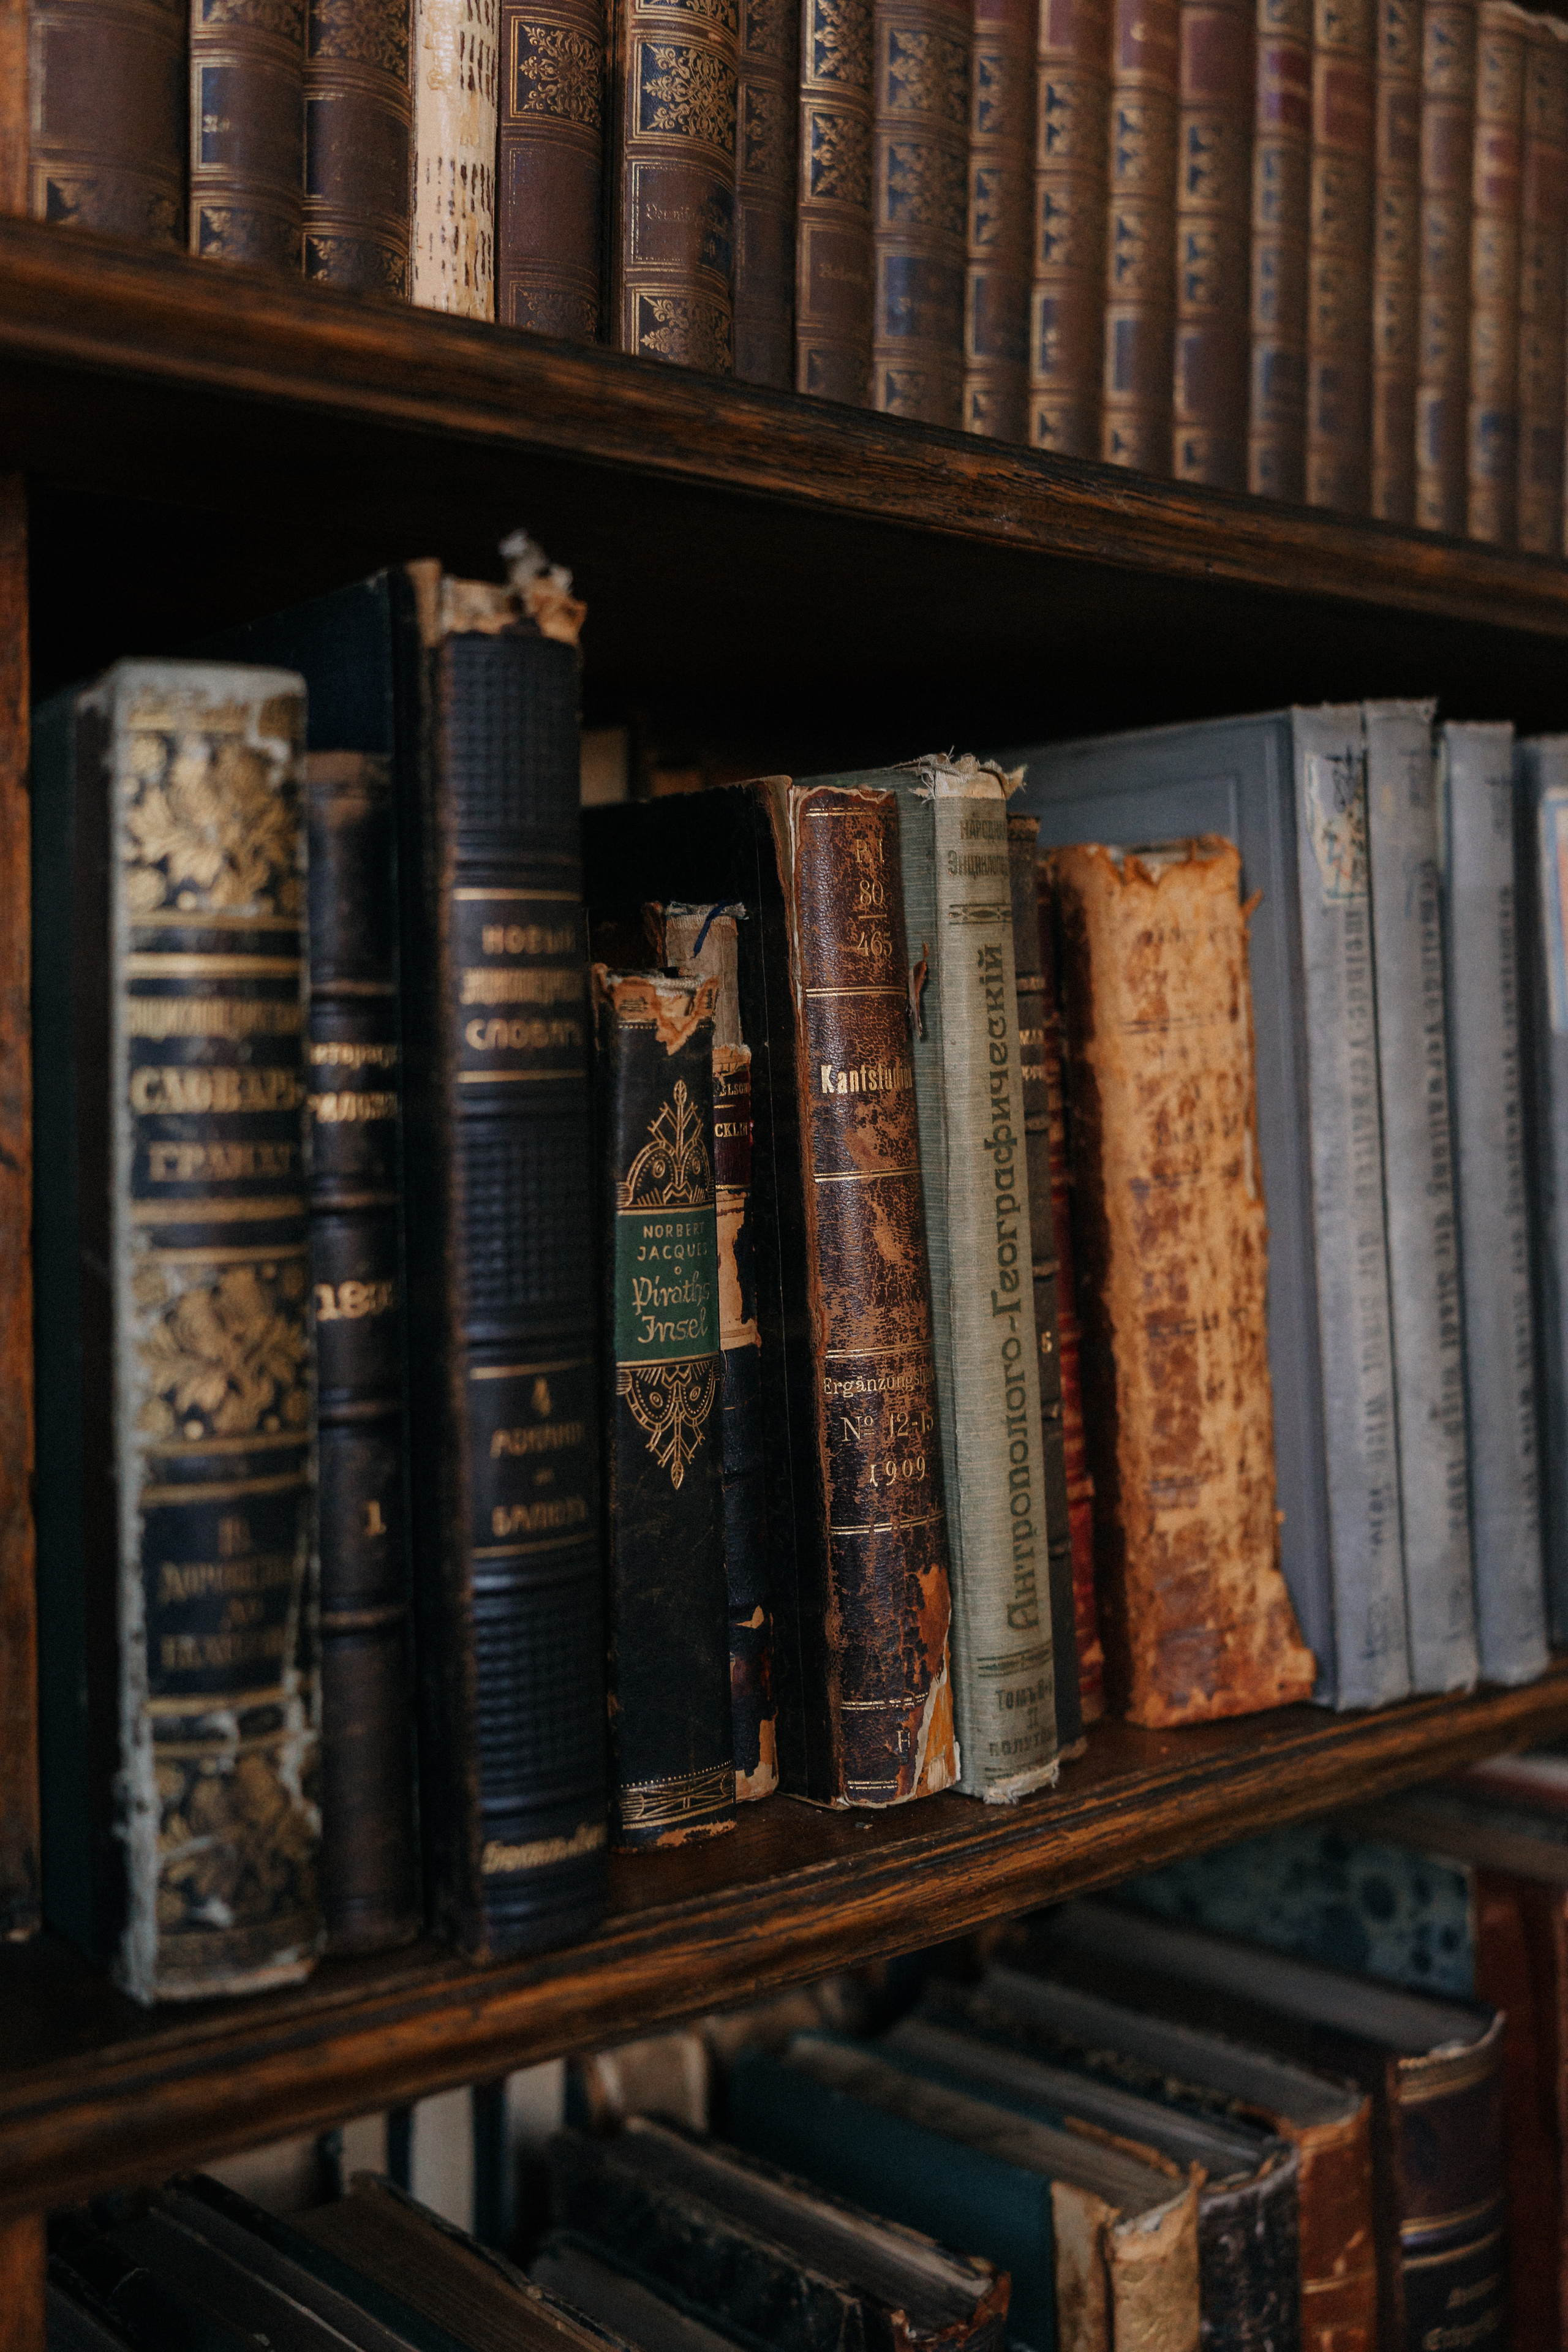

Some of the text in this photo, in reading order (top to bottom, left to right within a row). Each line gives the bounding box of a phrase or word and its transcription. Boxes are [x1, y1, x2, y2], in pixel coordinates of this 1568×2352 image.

[859, 880, 883, 906] 80
[857, 930, 892, 957] 465
[714, 1122, 748, 1137] CKLIN
[643, 1223, 704, 1238] NORBERT
[637, 1243, 707, 1262] JACQUES
[870, 1456, 925, 1487] 1909
